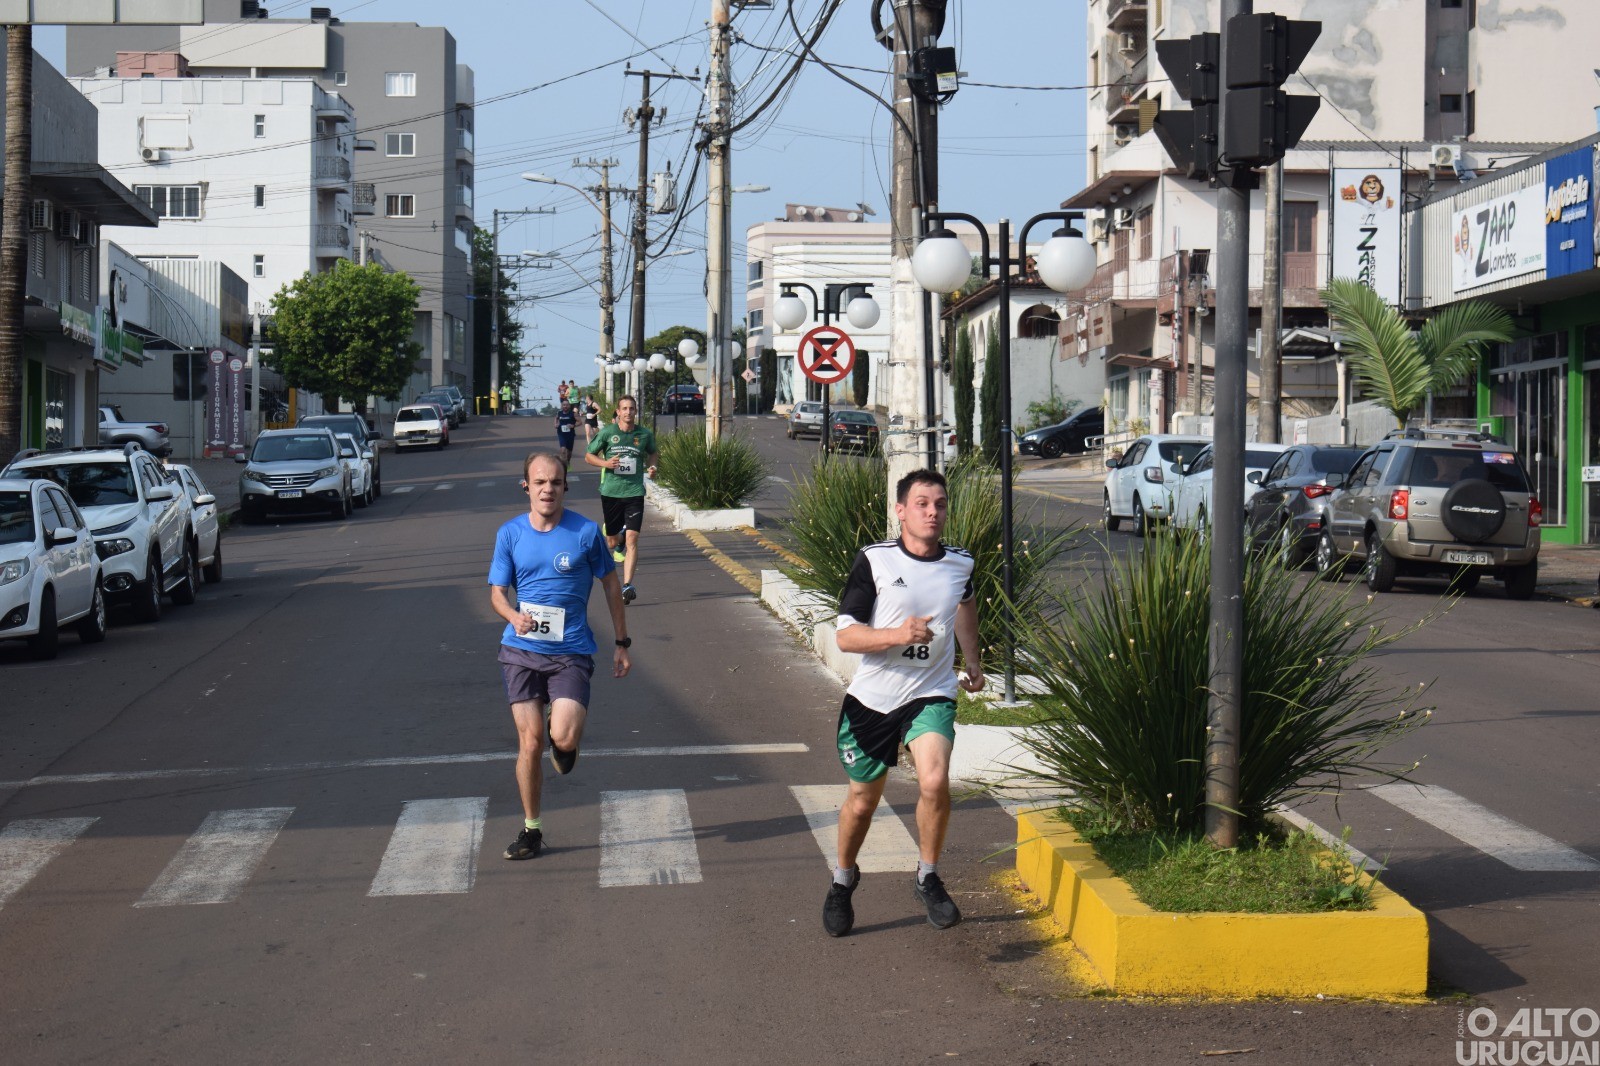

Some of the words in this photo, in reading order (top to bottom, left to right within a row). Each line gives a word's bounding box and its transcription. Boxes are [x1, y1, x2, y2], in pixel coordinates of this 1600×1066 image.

[1475, 201, 1516, 278] ZAAP
[1490, 247, 1516, 274] Lanches
[902, 645, 930, 660] 48
